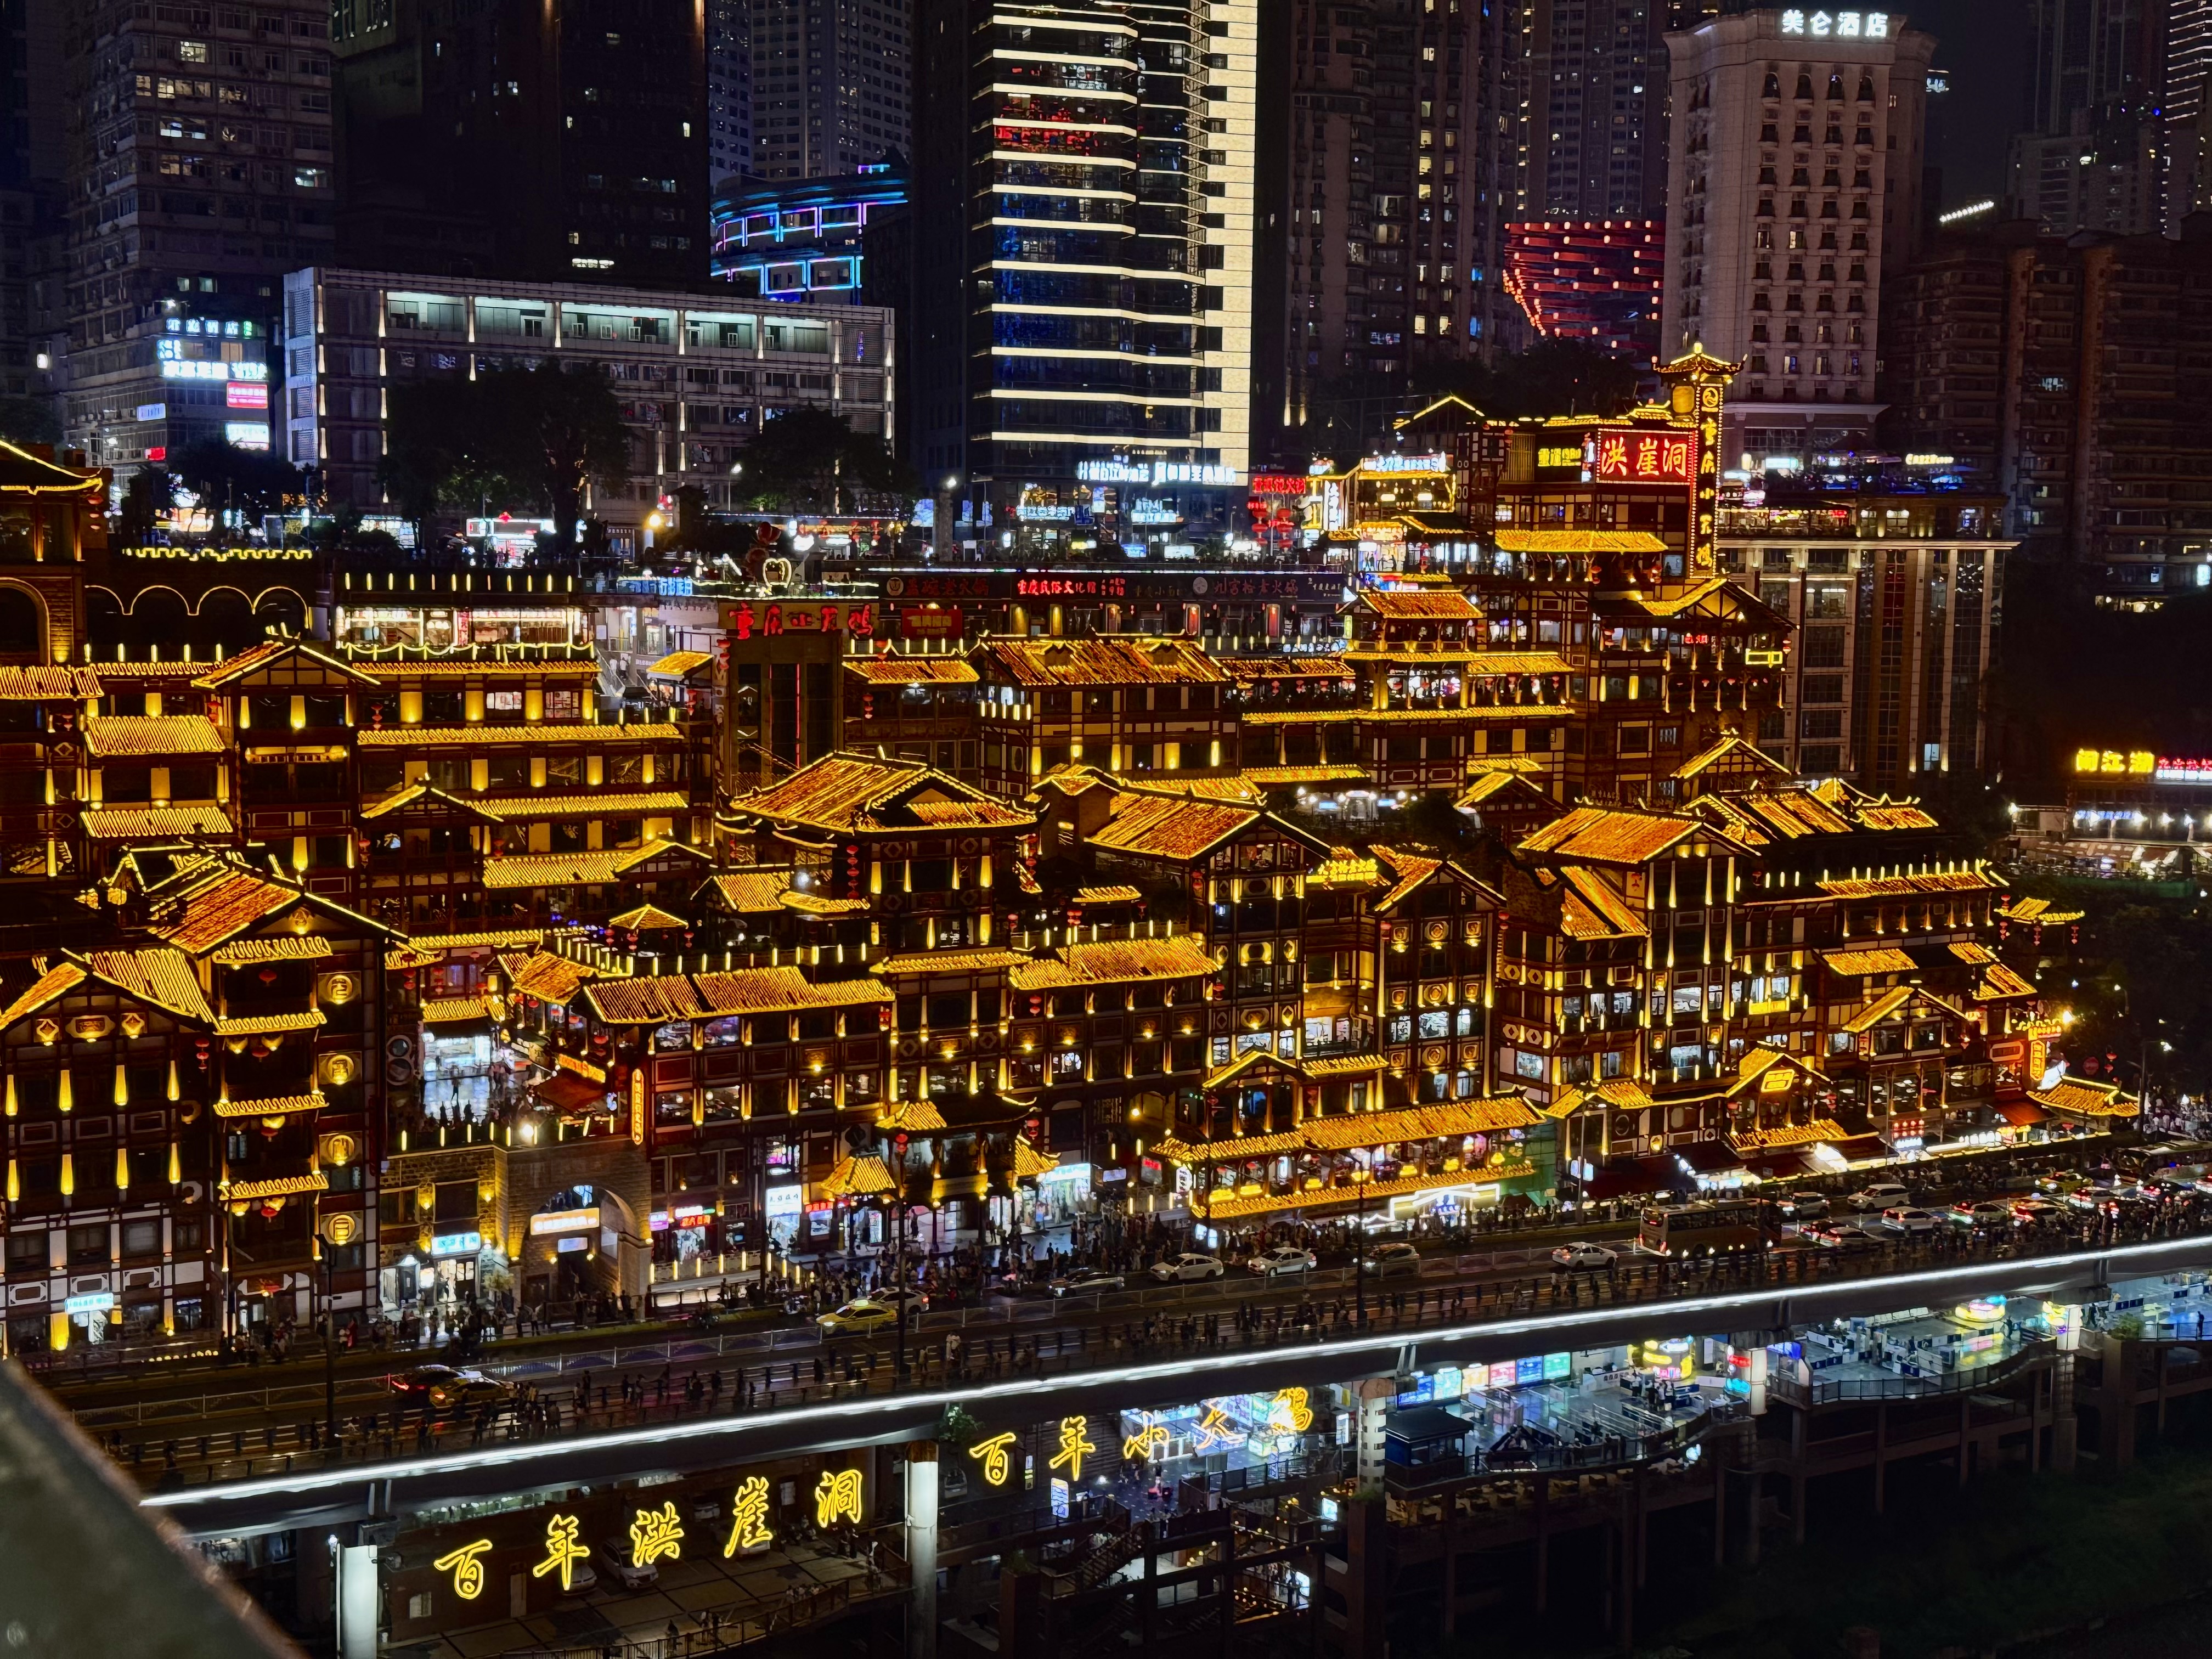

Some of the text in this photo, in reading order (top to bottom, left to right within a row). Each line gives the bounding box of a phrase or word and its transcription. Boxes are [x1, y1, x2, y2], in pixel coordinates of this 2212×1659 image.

[1782, 9, 1888, 37] 美仑酒店
[1600, 436, 1688, 476] 洪崖洞
[434, 1469, 863, 1600] 百年洪崖洞
